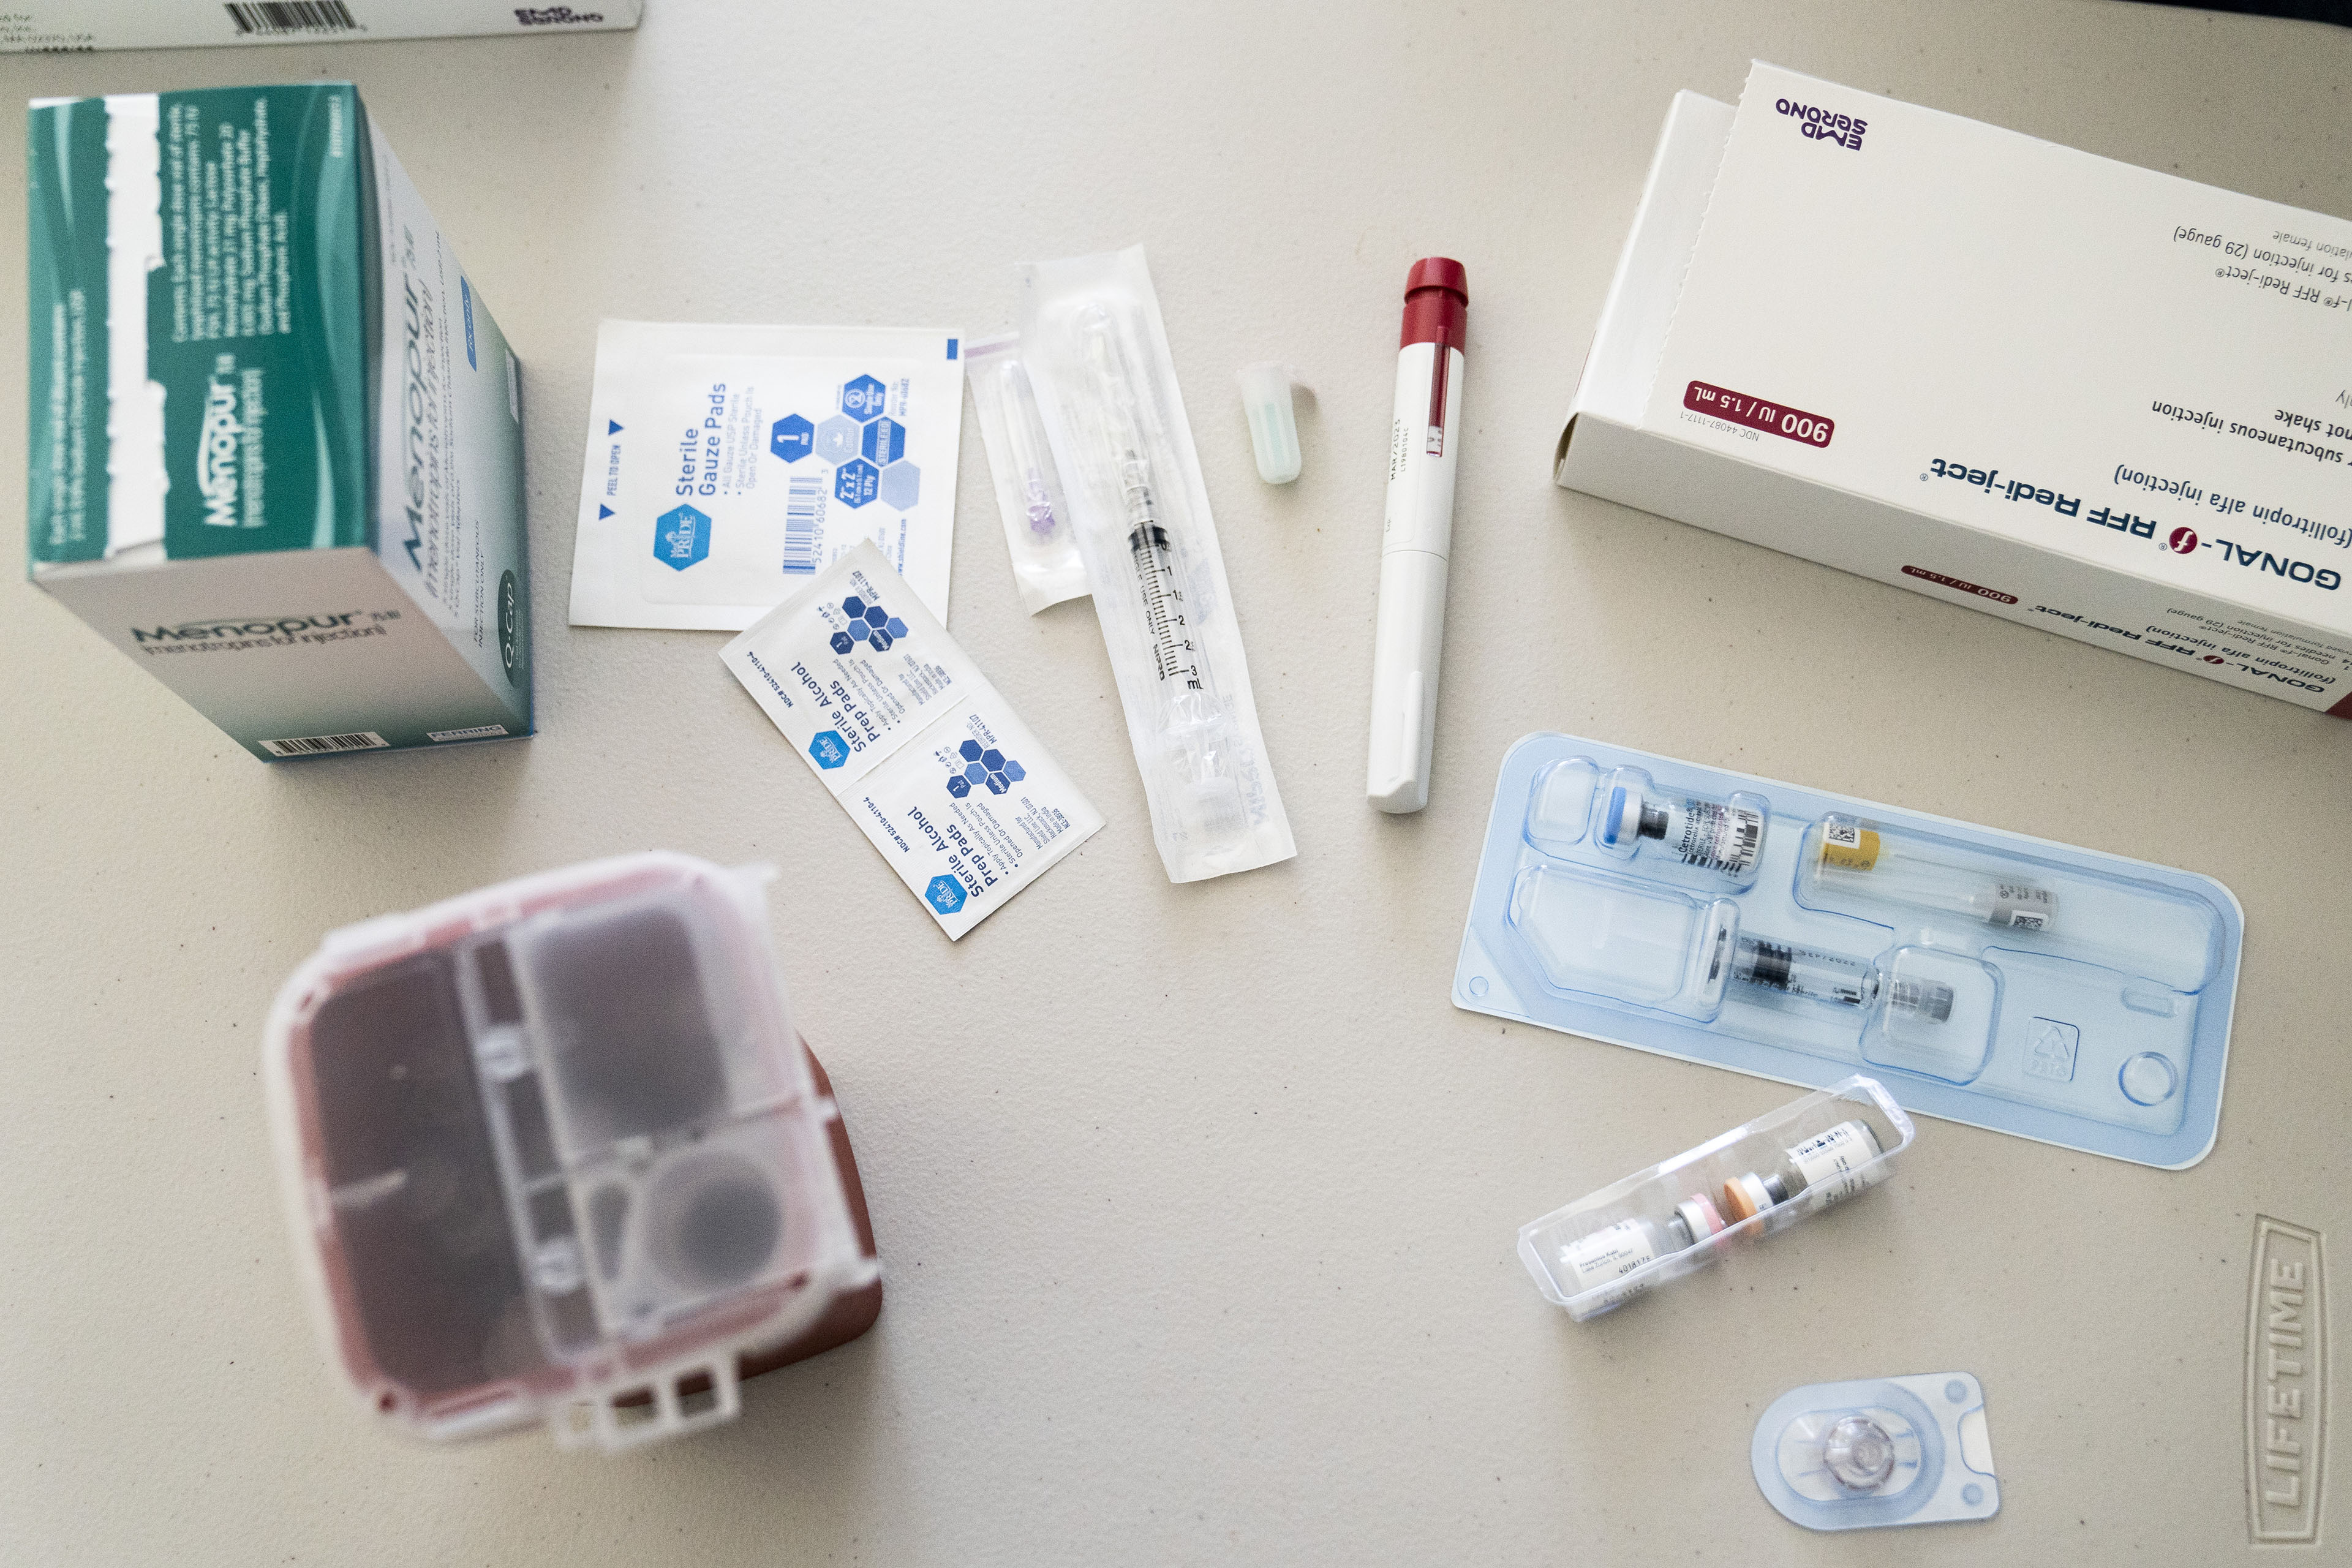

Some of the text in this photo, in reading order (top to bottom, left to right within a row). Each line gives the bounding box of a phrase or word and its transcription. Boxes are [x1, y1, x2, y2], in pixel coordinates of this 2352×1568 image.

[1773, 97, 1869, 135] SERONO
[1798, 121, 1863, 151] EMD
[2171, 224, 2340, 282] for injection (29 gauge)
[2270, 229, 2312, 251] female
[2292, 283, 2321, 303] RFF
[402, 273, 431, 573] Menopur
[741, 396, 753, 423] Pouch
[1679, 410, 1759, 442] NDC 44087-1117-1
[1691, 386, 1830, 444] 900 IU / 1.5 mL
[2272, 407, 2322, 435] shake
[698, 382, 726, 496] Gauze Pads
[722, 393, 740, 488] All Gauze USP Sterile
[738, 425, 750, 456] Unless
[747, 408, 763, 489] Open Or Damaged
[777, 434, 799, 443] 1
[878, 431, 889, 463] STERILE
[2149, 395, 2343, 467] subcutaneous injection
[606, 444, 621, 496] PEEL TO OPEN
[676, 428, 698, 496] Sterile
[735, 458, 746, 488] Sterile
[865, 475, 875, 487] Ply
[815, 488, 827, 522] 60682
[2086, 502, 2158, 540] RFF
[2111, 461, 2352, 550] (follitropin alfa injection)
[812, 527, 824, 563] 52410
[895, 518, 907, 576] ww.shieldline.com
[1909, 566, 1926, 576] mL
[1929, 572, 1947, 582] 1.5
[1138, 586, 1155, 635] USE ONLY
[1977, 587, 2011, 603] 900
[131, 611, 353, 646] Menopur
[2165, 605, 2336, 661] needles for injection (29 gauge)
[2257, 639, 2278, 650] RFF
[1152, 644, 1166, 681] NIPRO
[2144, 636, 2196, 657] RFF
[2144, 623, 2336, 685] (follitropin alfa injection)
[859, 657, 907, 714] Opened Or Damaged
[1186, 677, 1204, 693] mL
[1189, 665, 1197, 677] 3
[790, 660, 867, 753] Sterile Alcohol
[846, 658, 899, 720] Sterile Pouch Is
[826, 679, 883, 742] Prep Pads
[969, 712, 997, 744] MPR-41107
[971, 728, 990, 749] REORDER
[957, 778, 967, 788] Pad
[989, 771, 1007, 793] Medium
[862, 795, 910, 853] NDC# 52410-4110-4
[968, 807, 986, 826] Pouch
[1020, 796, 1057, 839] Hackensack, NJ 07601
[1023, 812, 1050, 844] Shield Line LLC,
[1040, 805, 1052, 818] India
[1052, 820, 1064, 833] Made
[949, 801, 1008, 871] Apply Topically As Needed
[976, 801, 1024, 858] Opened Or Damaged
[982, 824, 1001, 845] Unless
[1014, 815, 1044, 850] Manufactured for
[906, 804, 985, 898] Sterile Alcohol
[943, 822, 1000, 887] Prep Pads
[998, 842, 1016, 864] Sterile
[935, 880, 959, 906] PRIDE
[2258, 1257, 2313, 1507] LIFETIME
